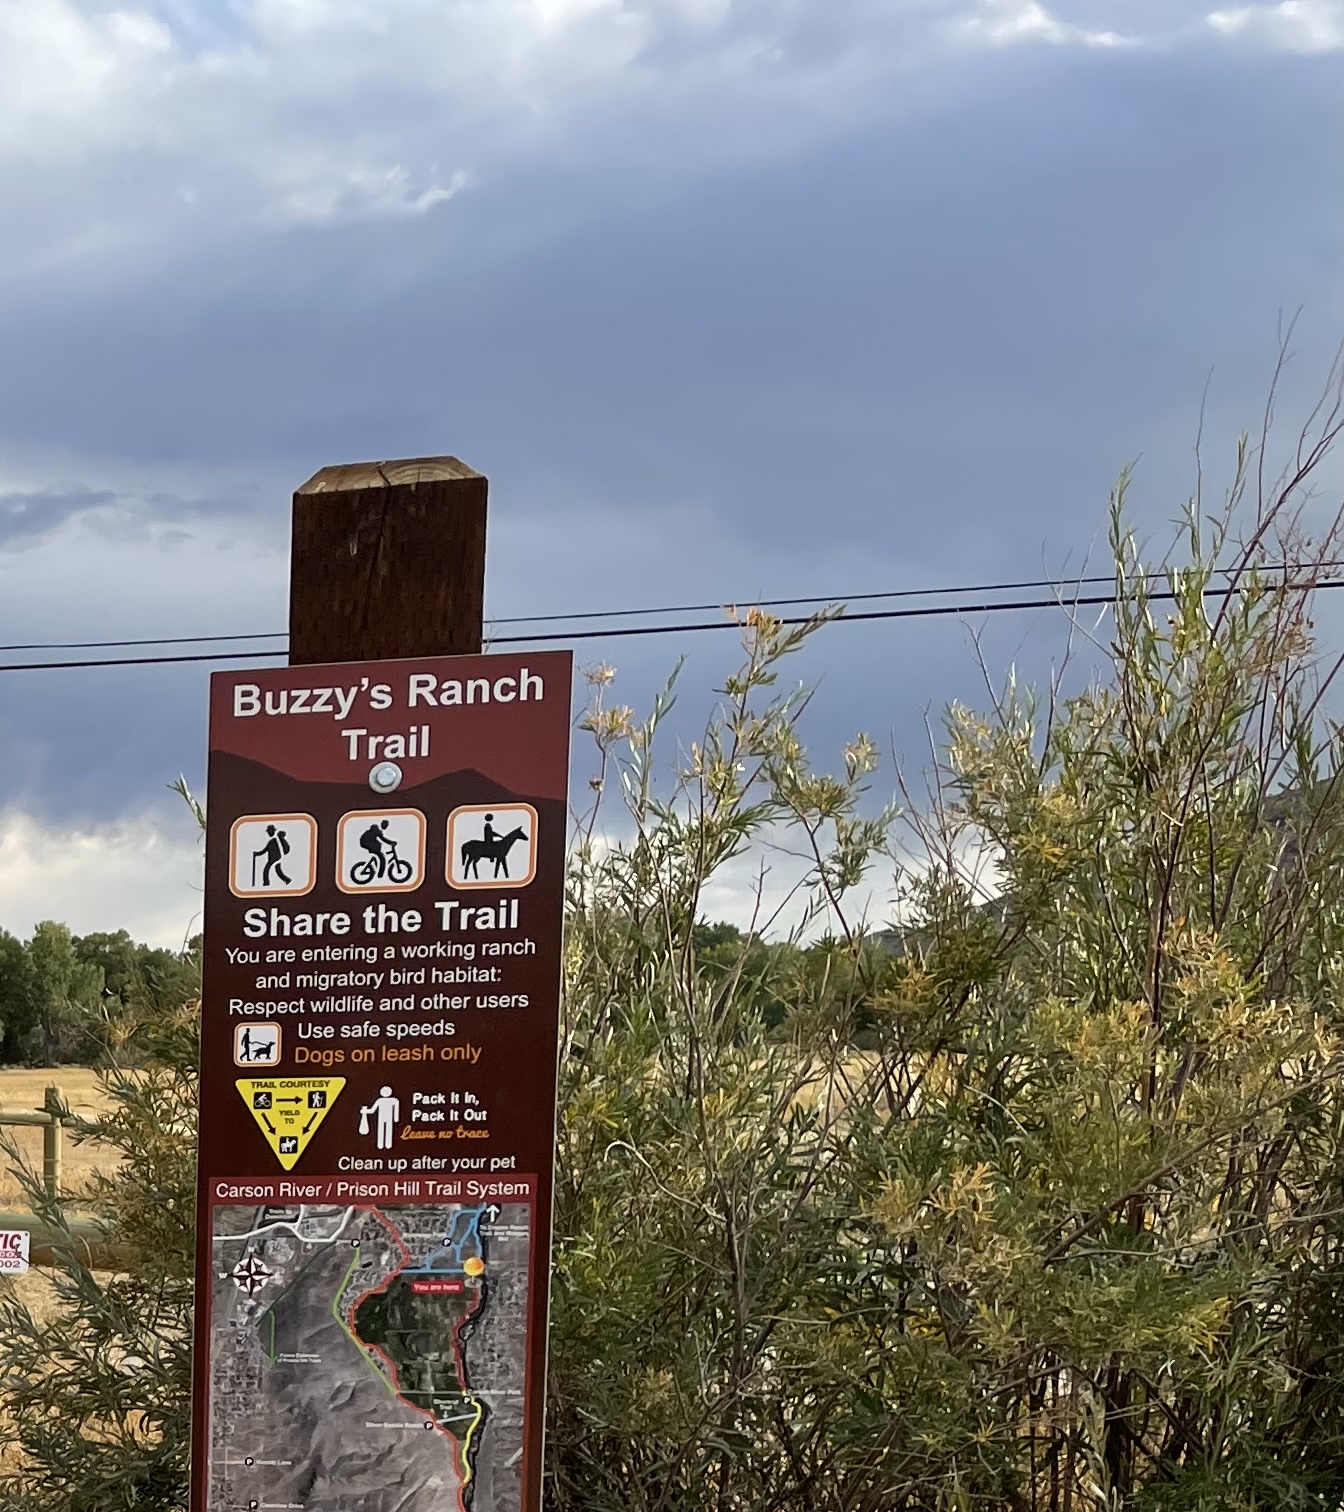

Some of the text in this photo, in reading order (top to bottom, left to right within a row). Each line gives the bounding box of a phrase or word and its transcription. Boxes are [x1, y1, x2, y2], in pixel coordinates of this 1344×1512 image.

[233, 668, 543, 720] Buzzy’s Ranch
[341, 725, 429, 760] Trail
[244, 899, 519, 938] Share the Trail
[225, 939, 536, 964] You are entering a working ranch
[256, 966, 501, 990] and migratory bird habitat:
[229, 993, 529, 1018] Respect wildlife and other users
[298, 1020, 455, 1040] Use safe speeds
[295, 1044, 482, 1066] Dogs on leash only
[251, 1080, 330, 1089] TRAIL COURTESY
[413, 1092, 479, 1106] Pack It In,
[412, 1109, 487, 1122] Pack It Out
[401, 1127, 436, 1140] leave
[456, 1126, 489, 1138] trace
[338, 1156, 516, 1172] Clean up after your pet
[216, 1181, 529, 1198] Carson River / Prison Hill Trail System
